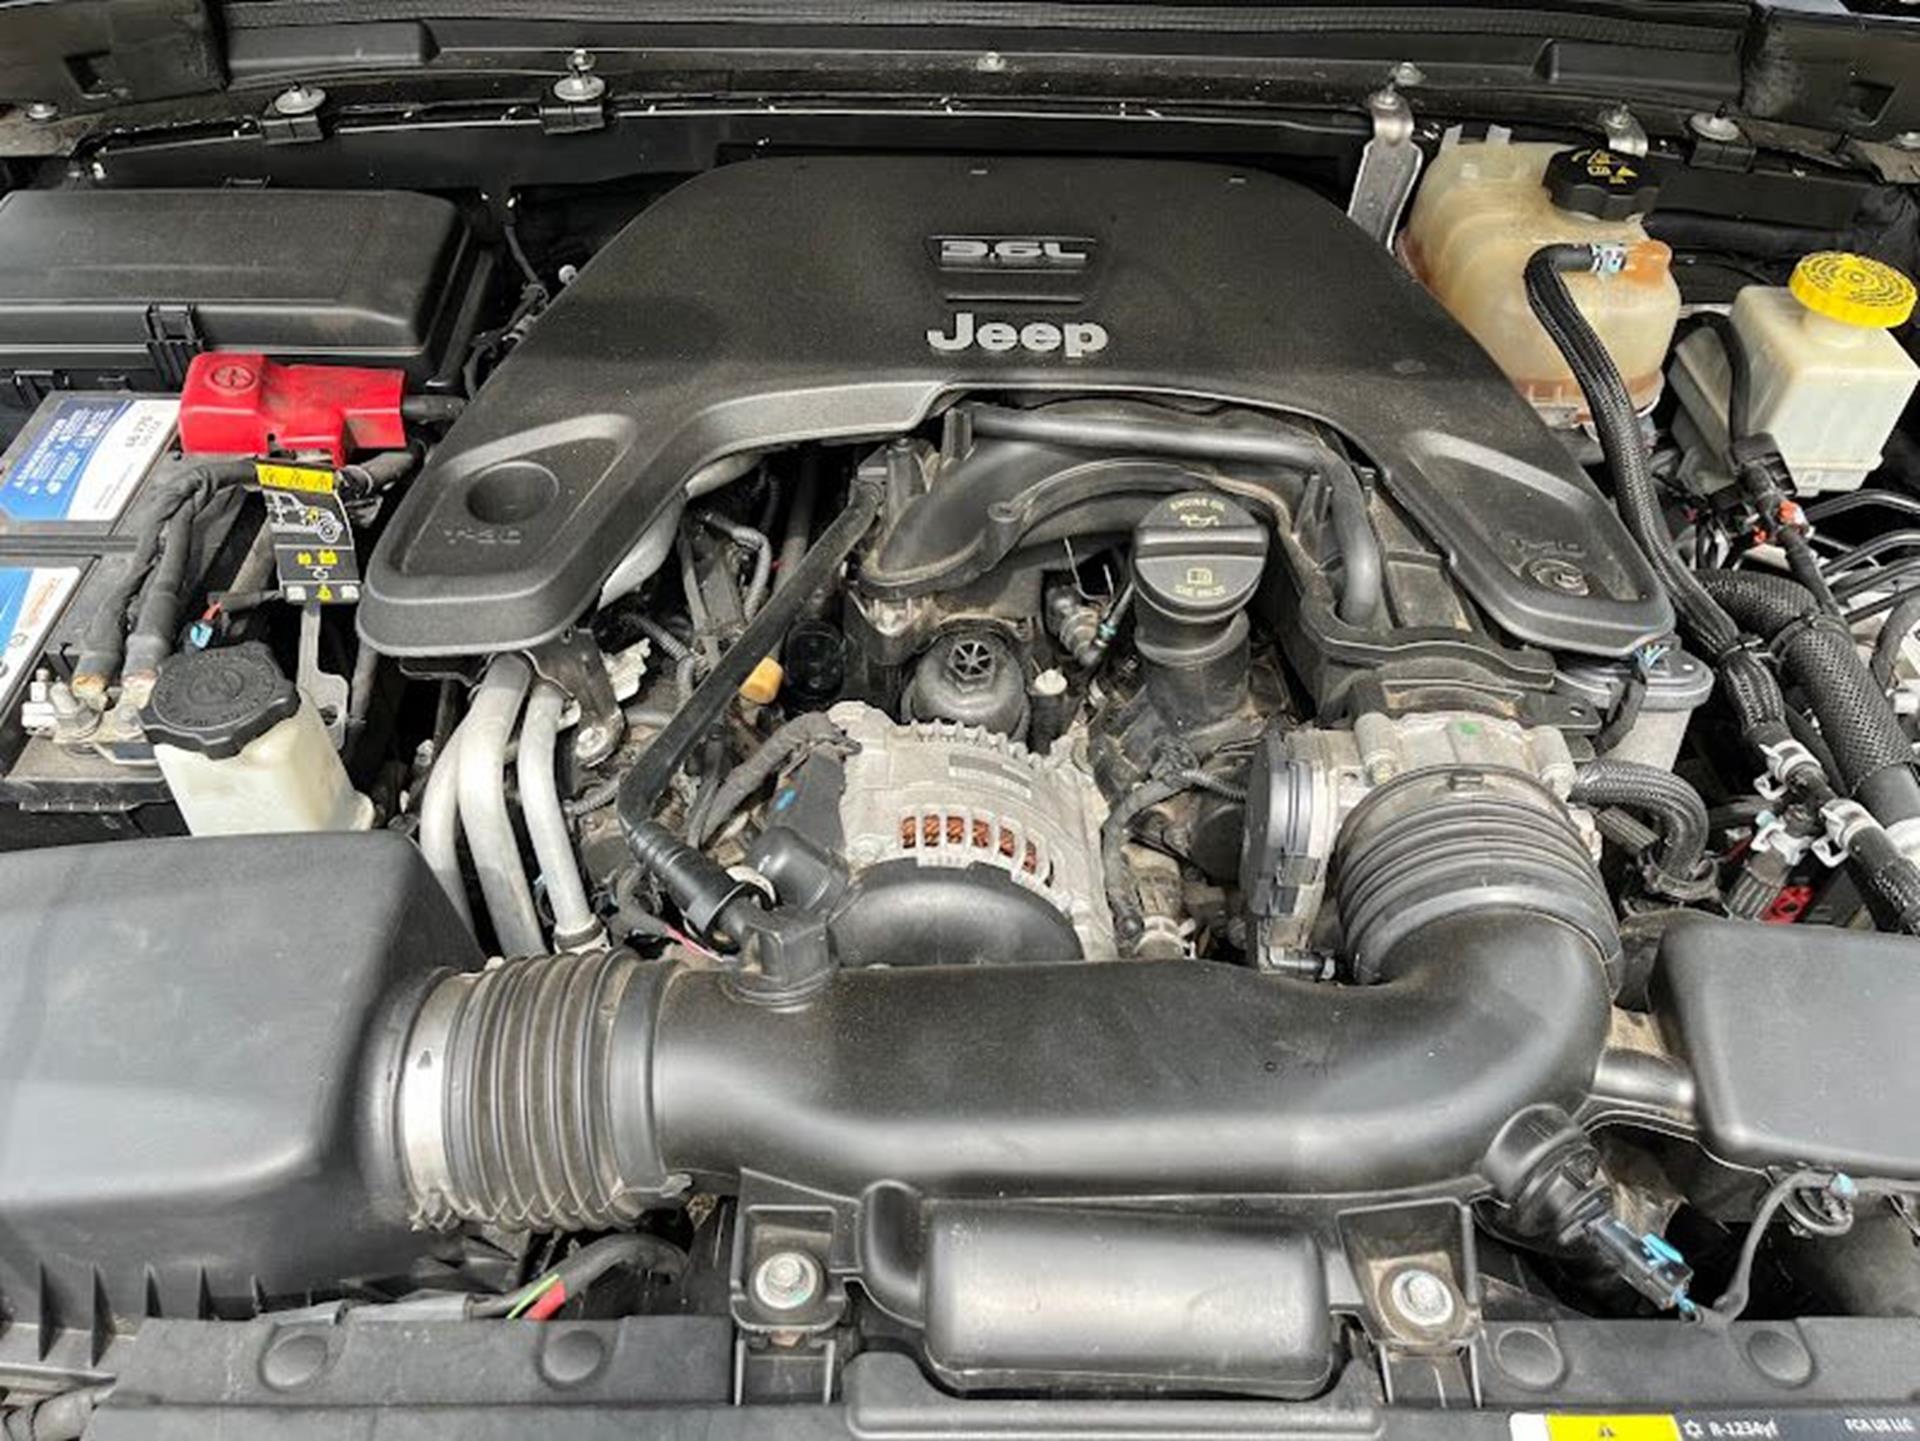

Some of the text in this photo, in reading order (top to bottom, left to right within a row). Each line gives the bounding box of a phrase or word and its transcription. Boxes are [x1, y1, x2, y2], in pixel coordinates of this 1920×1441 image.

[940, 239, 1087, 261] 3.6L
[926, 312, 1109, 358] Jeep
[1844, 1418, 1873, 1432] FCA
